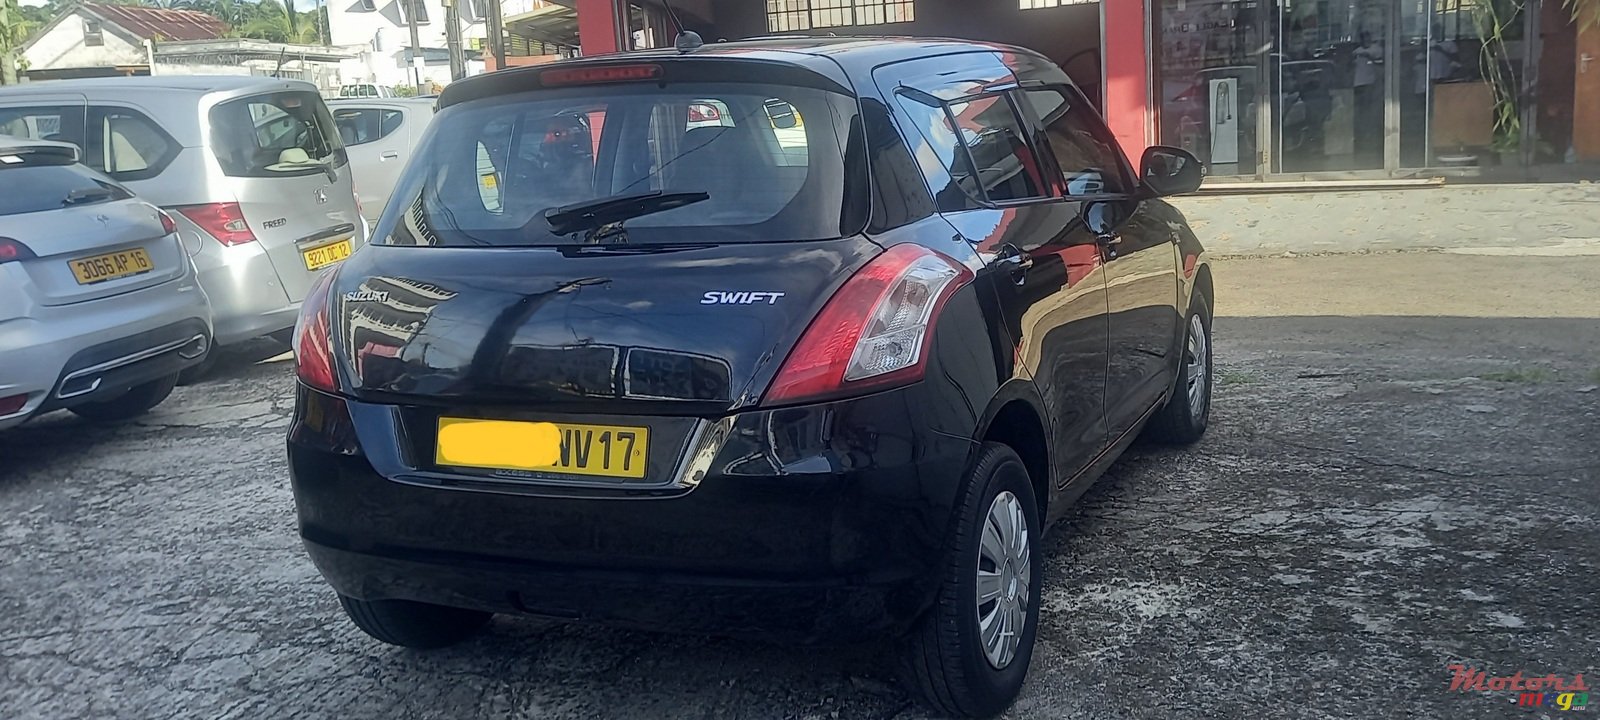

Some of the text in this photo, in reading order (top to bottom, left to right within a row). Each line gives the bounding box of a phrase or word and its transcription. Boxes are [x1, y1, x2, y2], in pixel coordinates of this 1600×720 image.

[262, 217, 287, 230] FREED
[308, 250, 326, 267] 9221
[339, 243, 348, 257] 12
[77, 257, 115, 280] 3066
[113, 254, 128, 273] AP
[130, 251, 147, 268] 16
[345, 291, 389, 302] SUZUKI
[700, 291, 785, 304] SWIFT
[598, 430, 636, 471] 17
